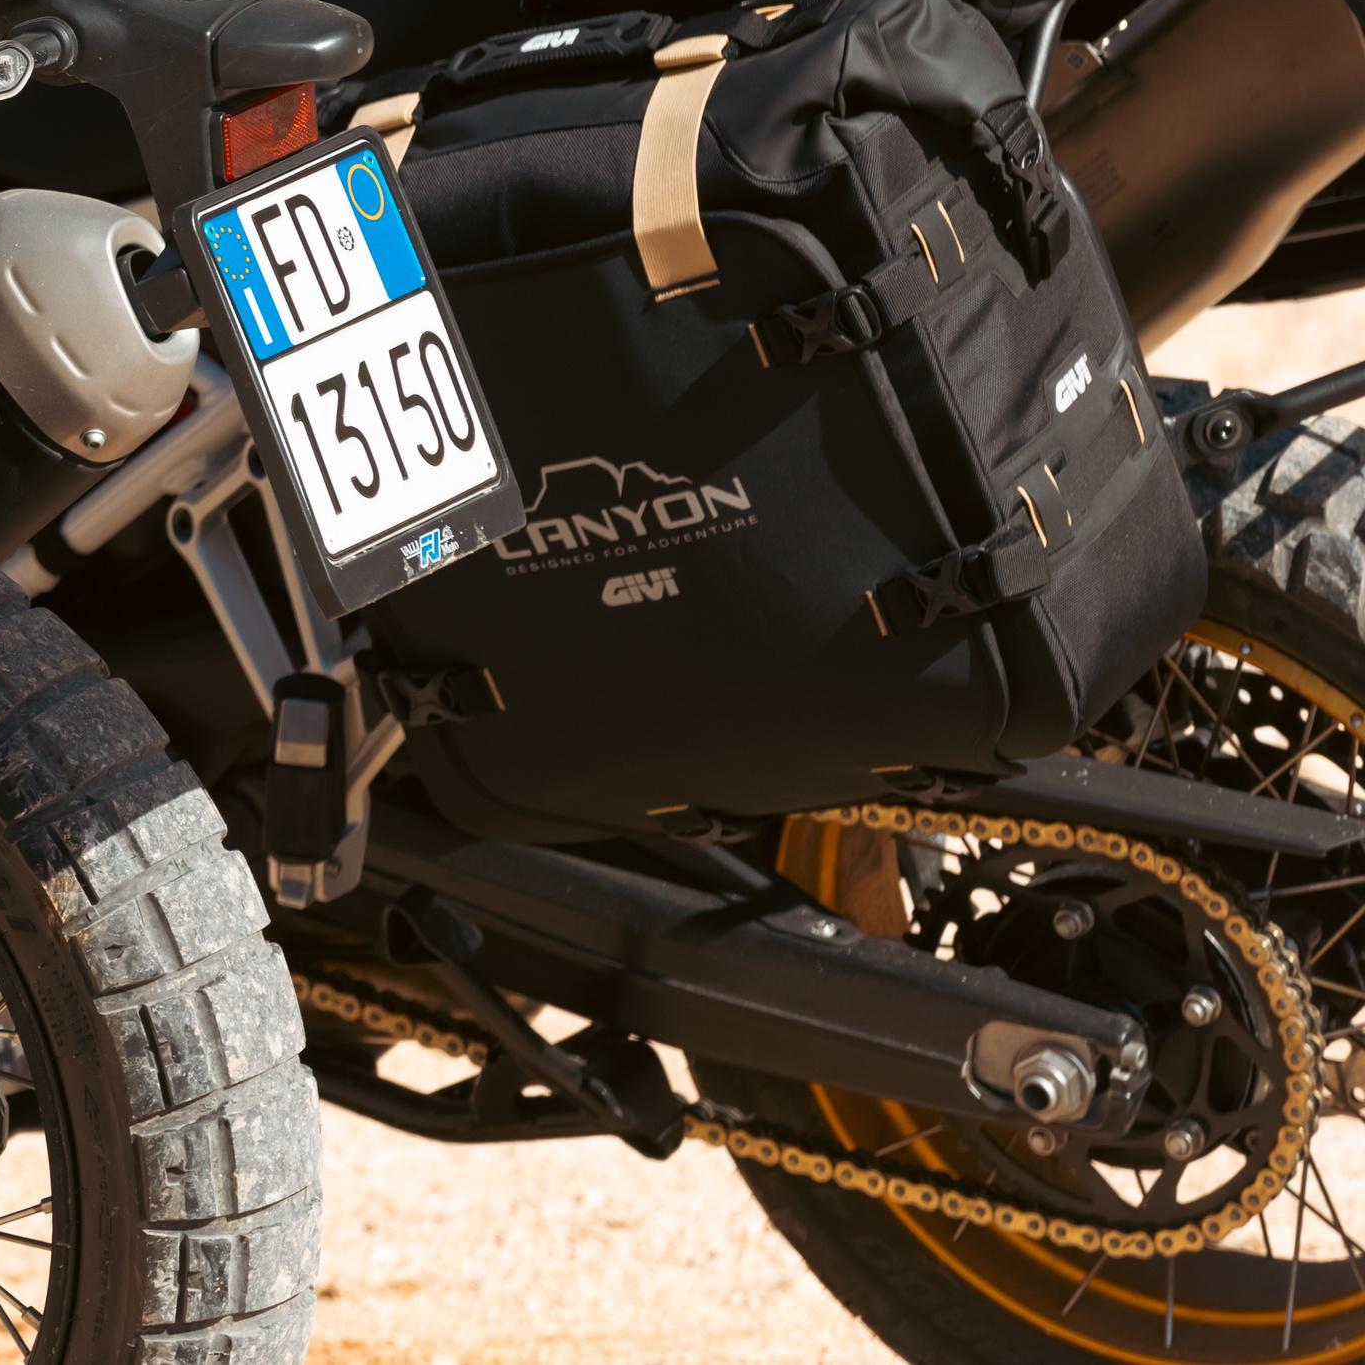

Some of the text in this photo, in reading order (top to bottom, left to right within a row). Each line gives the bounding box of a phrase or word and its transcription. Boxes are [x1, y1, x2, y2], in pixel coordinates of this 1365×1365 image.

[251, 194, 351, 333] FD
[1055, 352, 1093, 413] GIVI
[290, 330, 476, 516] 13150
[505, 514, 759, 576] DESIGNED FOR ADVENTURE
[602, 567, 680, 607] GIVI
